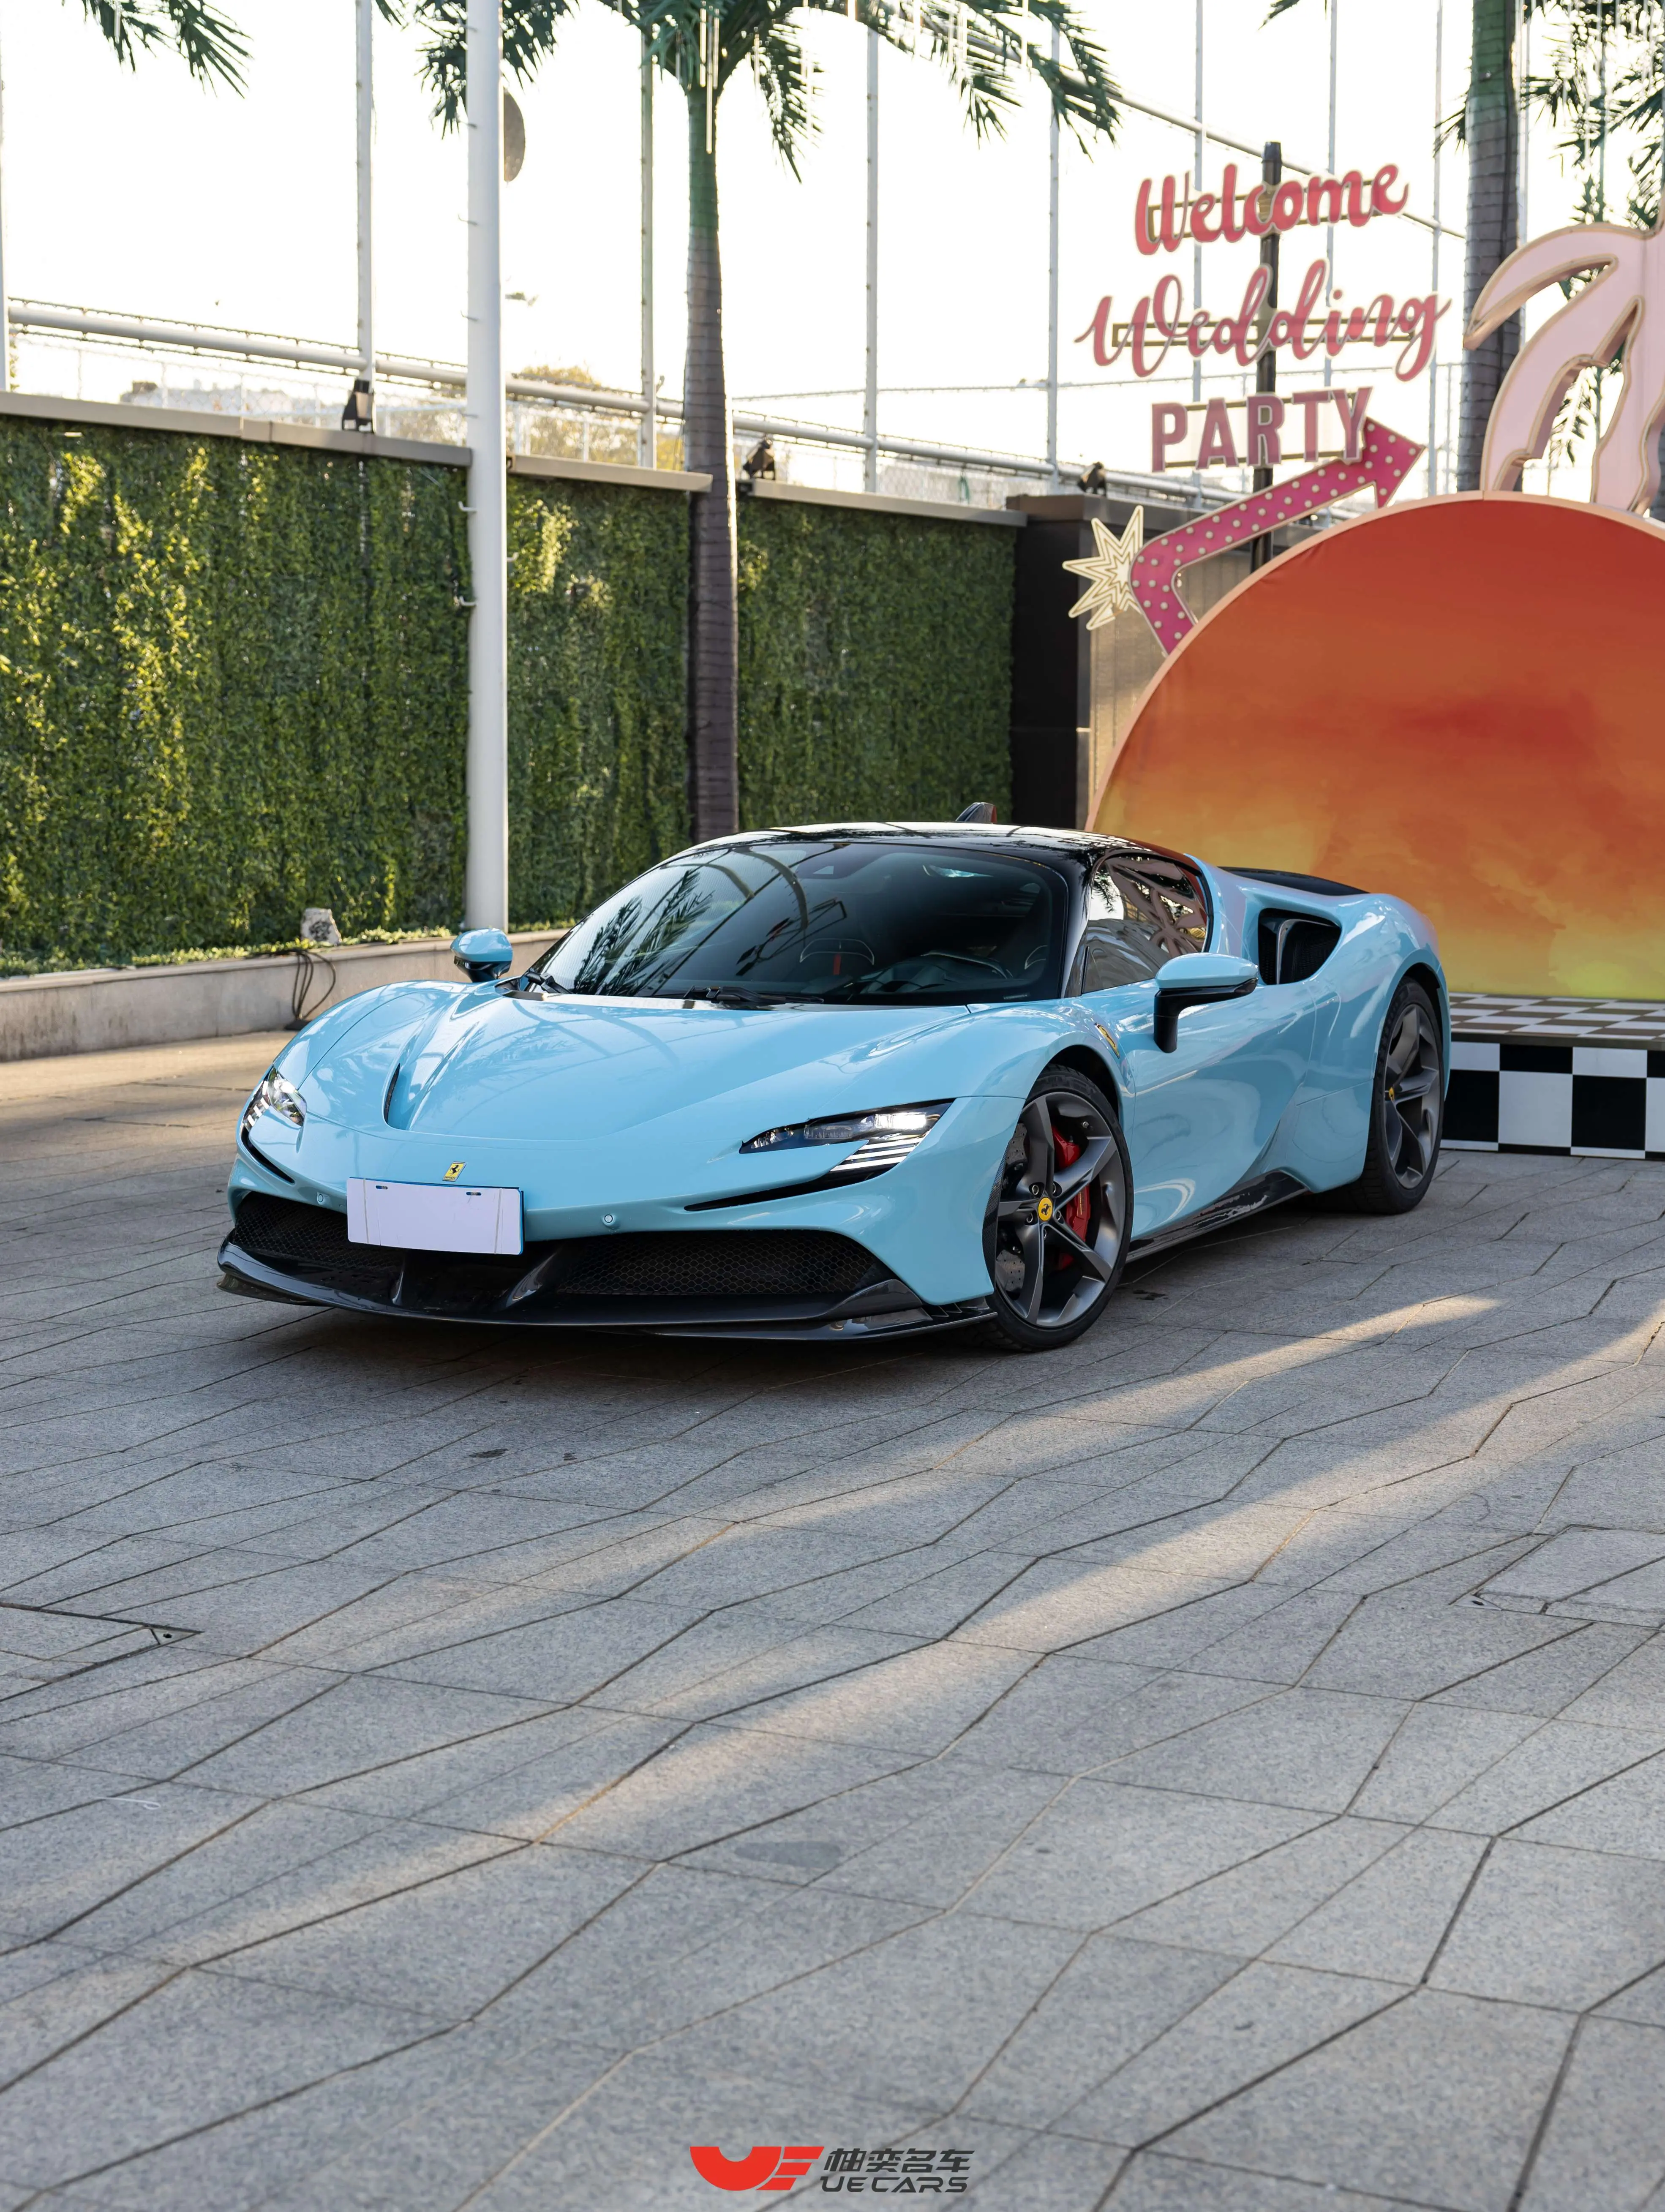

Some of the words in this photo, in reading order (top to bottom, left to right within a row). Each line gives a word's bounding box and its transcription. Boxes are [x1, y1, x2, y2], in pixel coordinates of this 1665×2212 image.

[1135, 163, 1409, 255] Welcome
[1074, 259, 1452, 382] Wedding
[1151, 387, 1373, 473] PARTY
